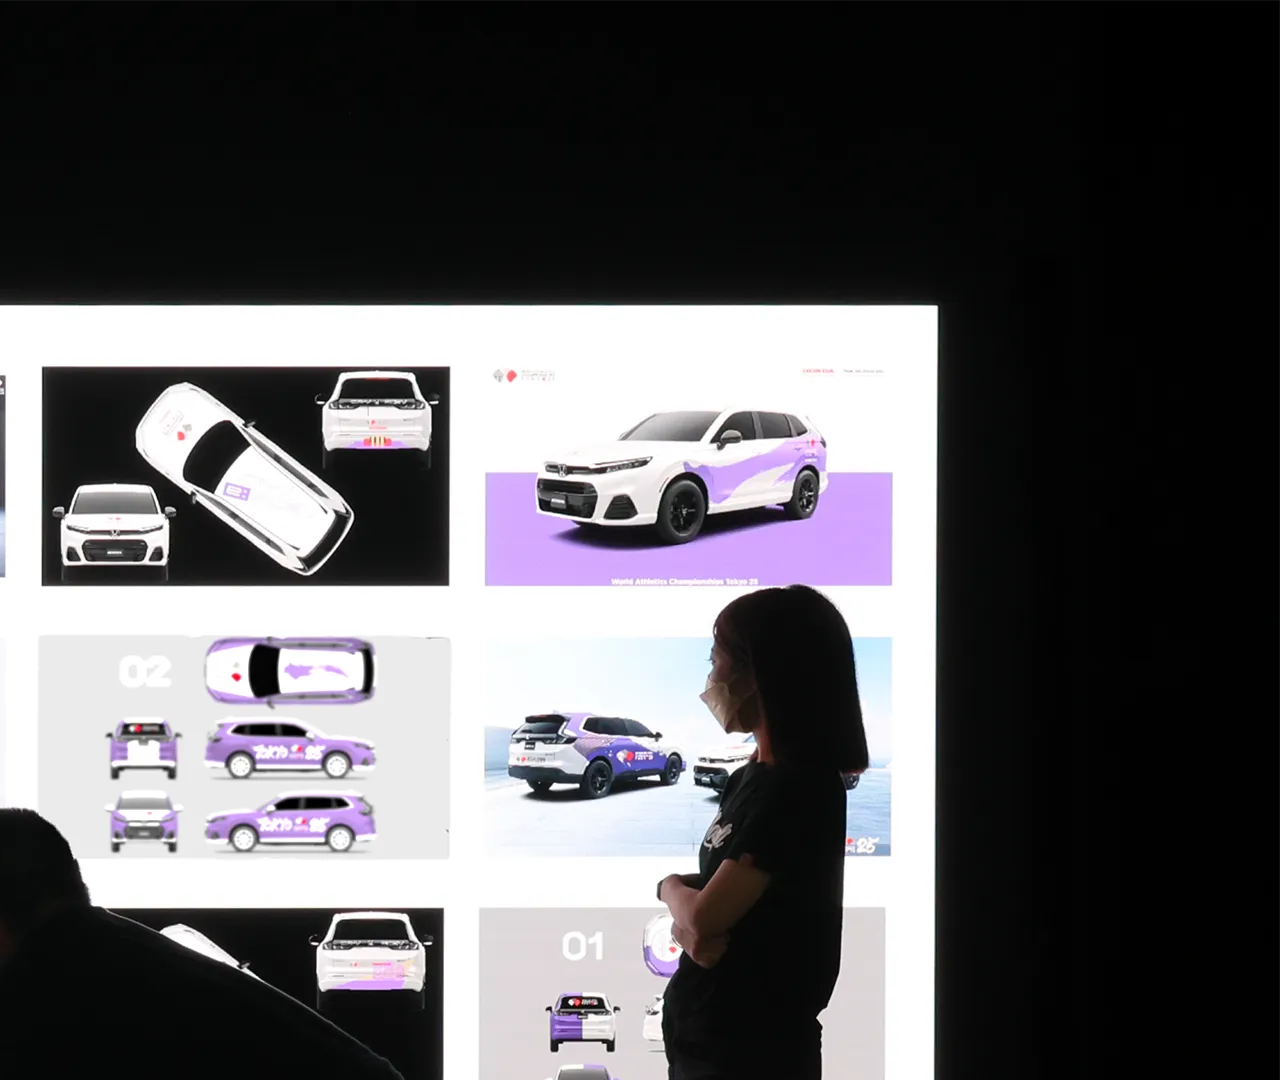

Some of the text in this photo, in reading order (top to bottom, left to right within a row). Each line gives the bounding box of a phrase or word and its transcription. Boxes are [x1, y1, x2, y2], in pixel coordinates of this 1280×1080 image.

[611, 578, 633, 586] World
[119, 654, 172, 688] 02
[562, 931, 603, 961] 01
